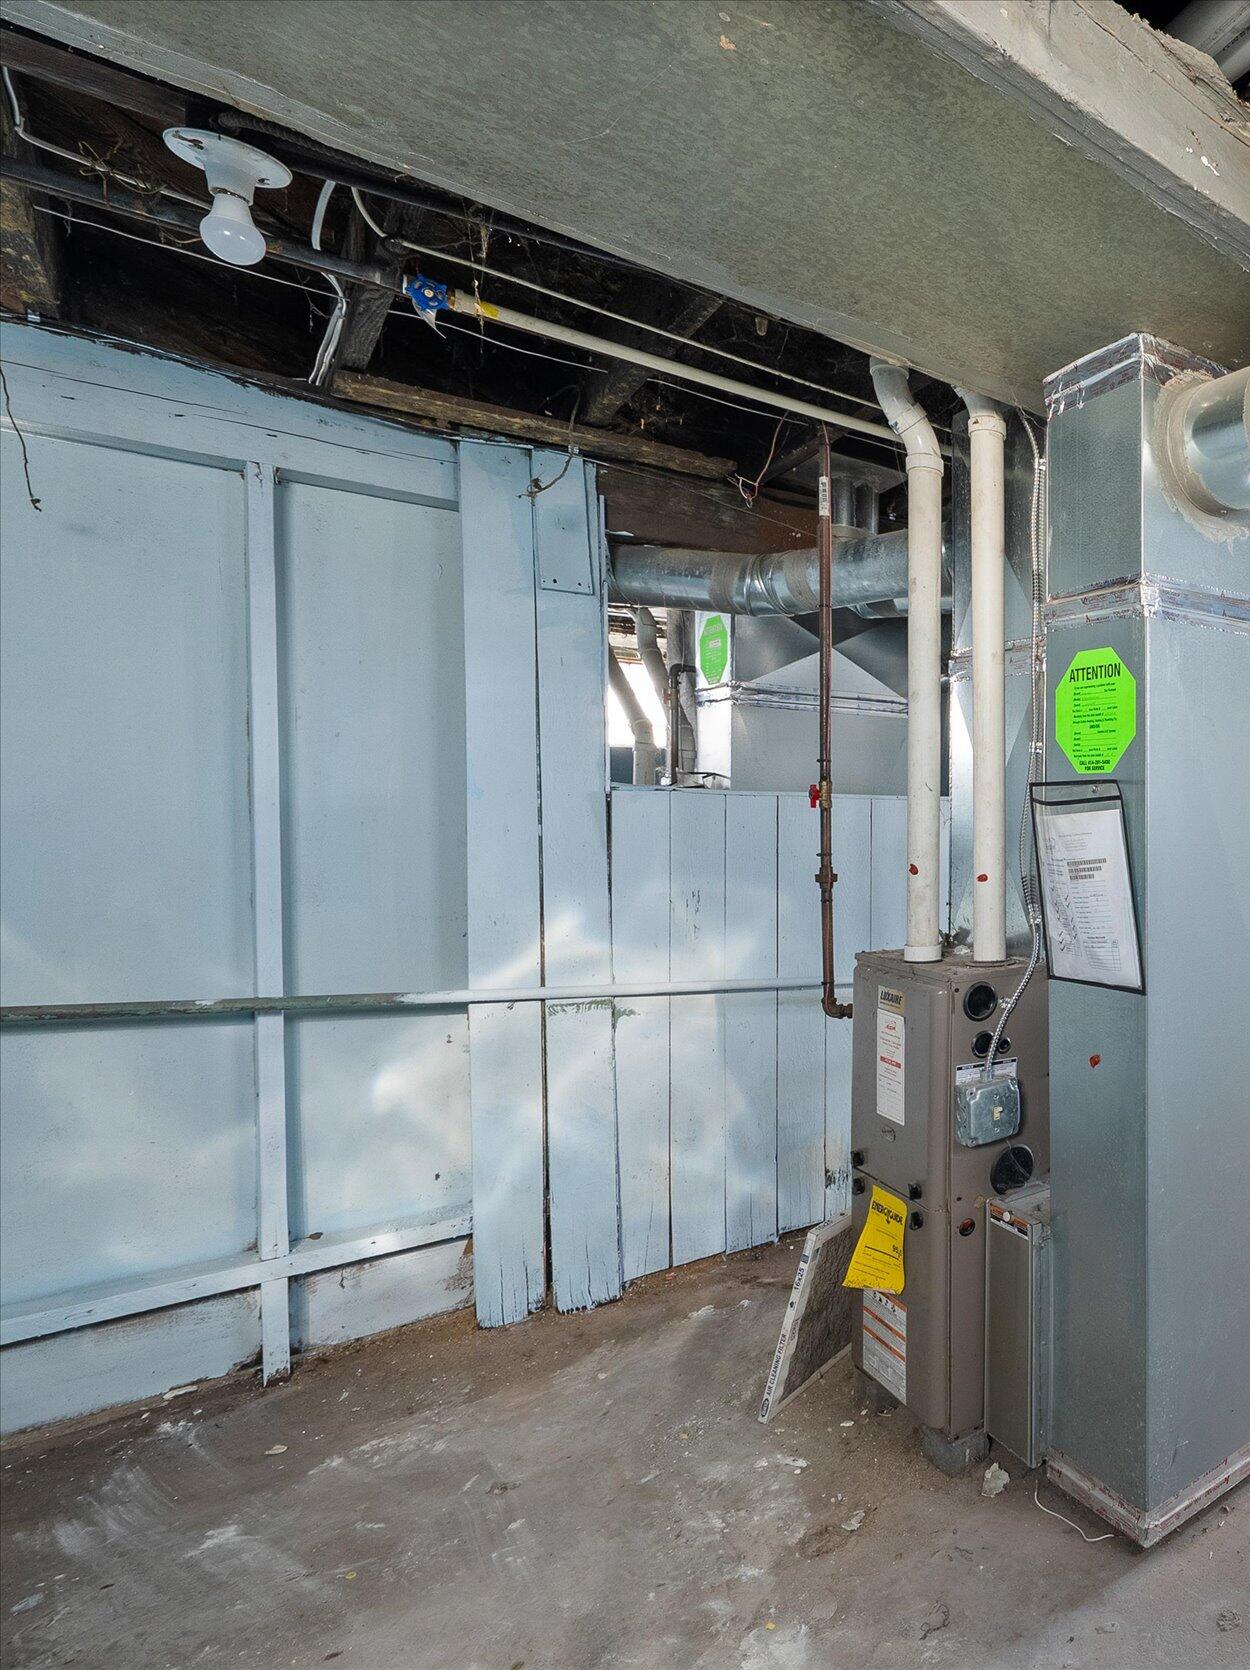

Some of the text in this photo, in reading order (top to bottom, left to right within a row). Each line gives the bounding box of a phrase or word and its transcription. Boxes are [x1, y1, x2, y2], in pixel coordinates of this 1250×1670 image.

[1069, 662, 1121, 683] ATTENTION
[794, 1267, 805, 1291] 16x25
[766, 1333, 787, 1397] AIR CLEANING FILTER
